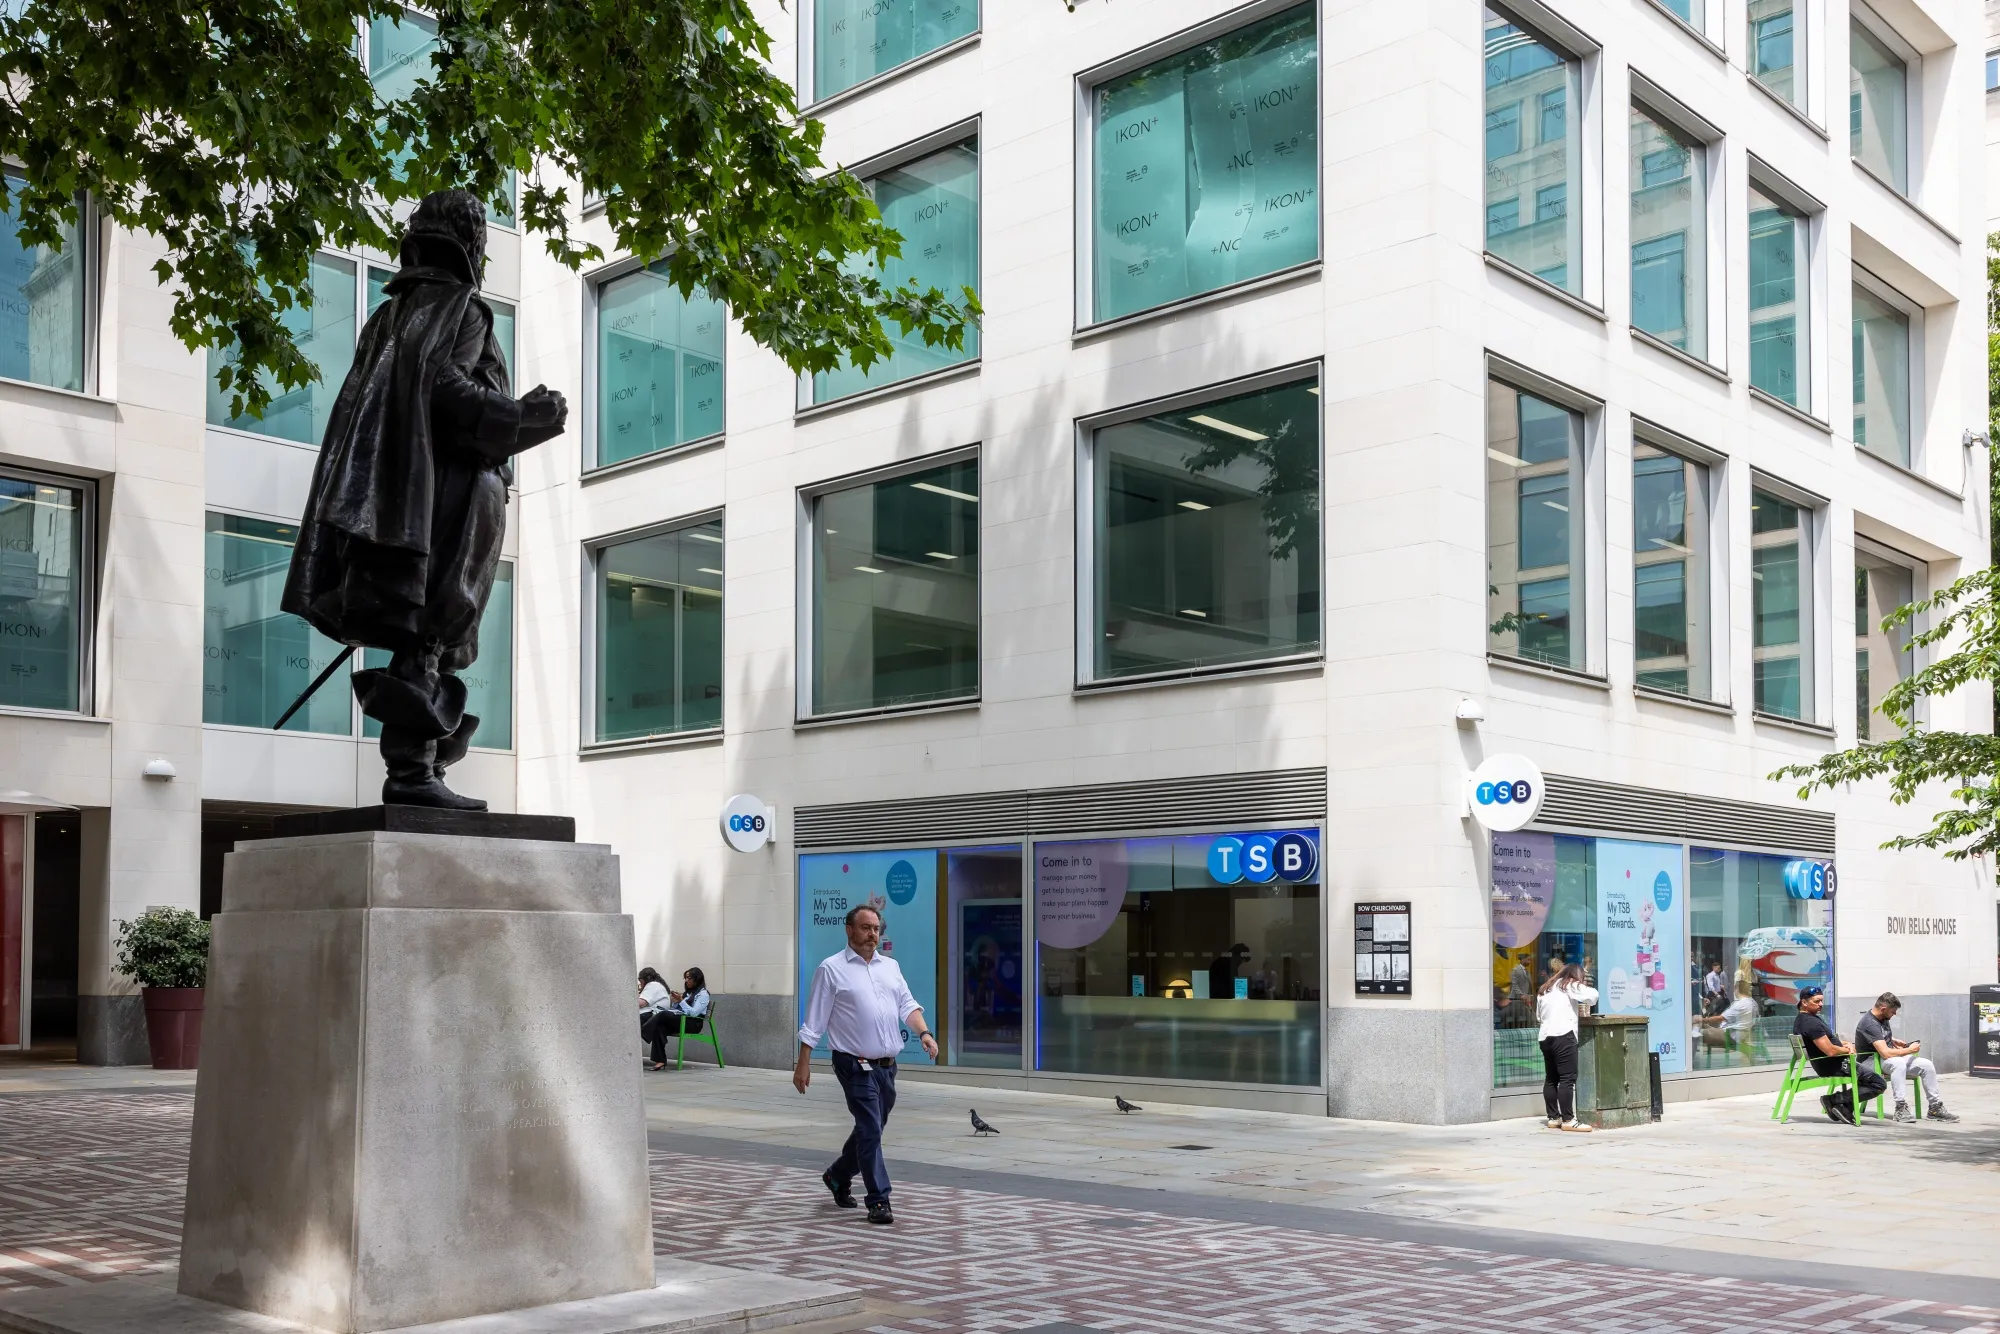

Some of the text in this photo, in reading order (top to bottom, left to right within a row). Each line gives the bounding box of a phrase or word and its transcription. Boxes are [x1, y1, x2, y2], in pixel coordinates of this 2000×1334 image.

[1254, 84, 1301, 113] IKON+
[1115, 116, 1159, 144] IKON+
[1264, 187, 1314, 213] IKON+
[914, 200, 950, 224] IKON+
[1115, 211, 1159, 238] IKON+
[611, 385, 638, 403] IKON+
[1479, 783, 1529, 802] TSB
[732, 816, 763, 830] TSB
[1214, 840, 1306, 876] TSB
[1493, 843, 1532, 859] Come in to
[1041, 855, 1093, 868] Come in to
[1800, 866, 1836, 896] TSB
[813, 888, 841, 896] Introducing
[813, 897, 848, 914] My TSB
[1607, 901, 1631, 916] My TSB
[1071, 912, 1096, 920] business
[1607, 916, 1636, 929] Rewards.
[1887, 916, 1957, 935] BOW BELLS HOUSE
